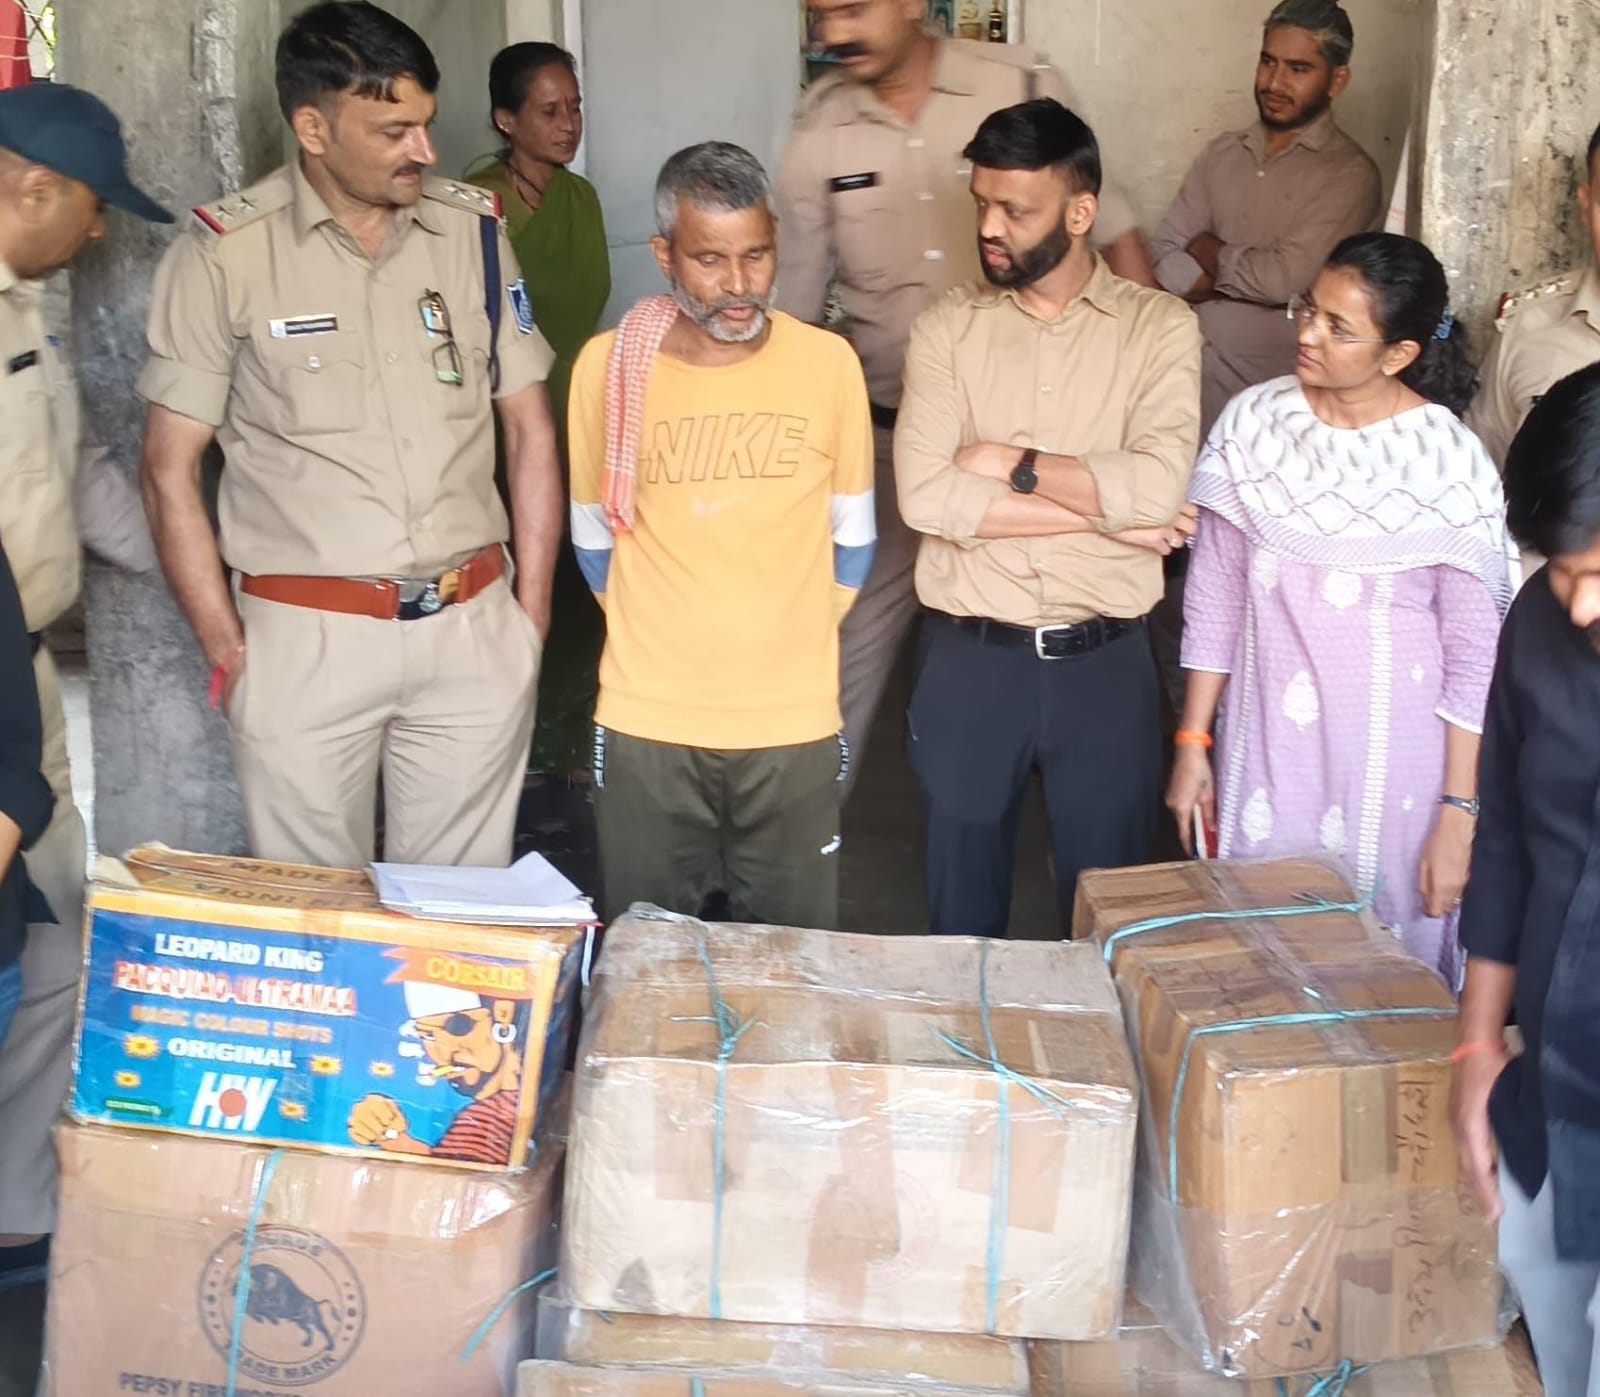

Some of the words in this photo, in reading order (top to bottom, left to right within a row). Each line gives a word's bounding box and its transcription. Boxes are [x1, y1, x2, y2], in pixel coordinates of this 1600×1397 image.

[646, 412, 809, 484] NIKE
[229, 861, 333, 883] MADE
[154, 933, 261, 966] LEOPARD
[264, 946, 324, 973] KING
[426, 956, 528, 992] CORSAIR
[167, 1037, 297, 1069] ORIGINAL
